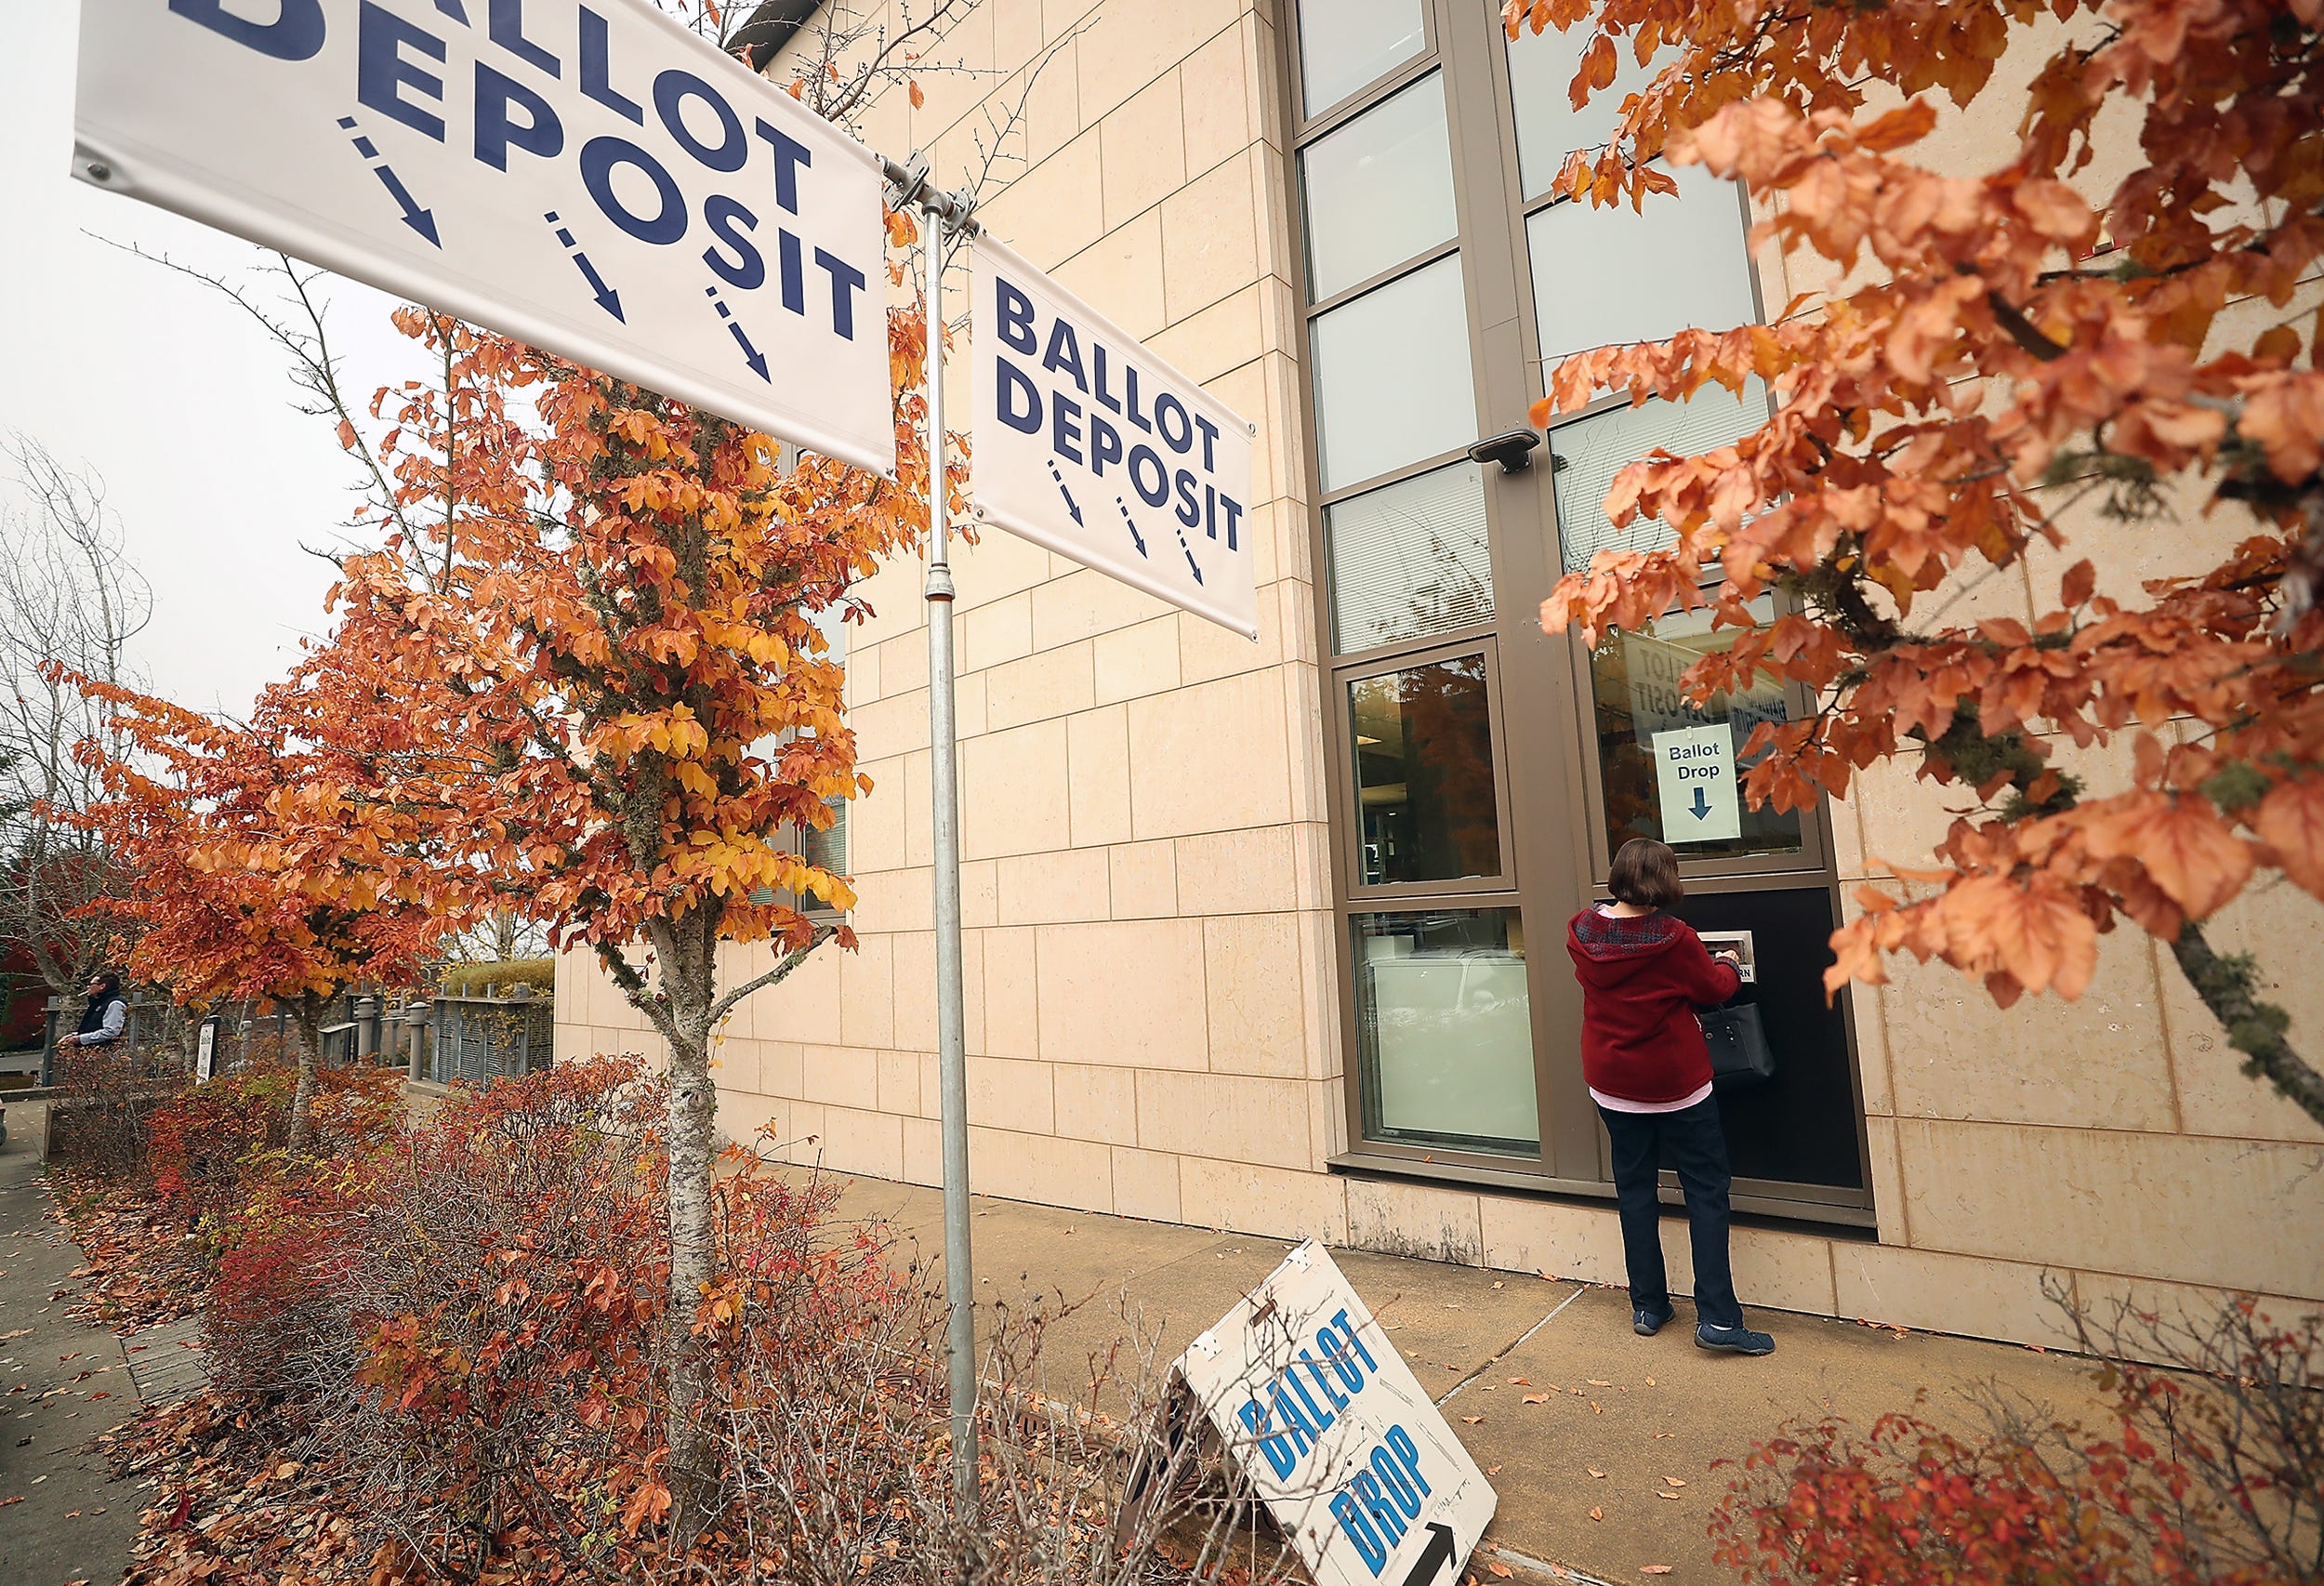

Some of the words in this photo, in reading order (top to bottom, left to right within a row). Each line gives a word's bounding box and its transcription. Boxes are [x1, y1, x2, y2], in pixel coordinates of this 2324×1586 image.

[996, 276, 1219, 473] BALLOT
[997, 355, 1242, 551] DEPOSIT
[1669, 743, 1720, 760] Ballot
[1678, 765, 1720, 780] Drop
[1237, 1308, 1378, 1483] BALLOT
[1328, 1424, 1431, 1578] DROP
